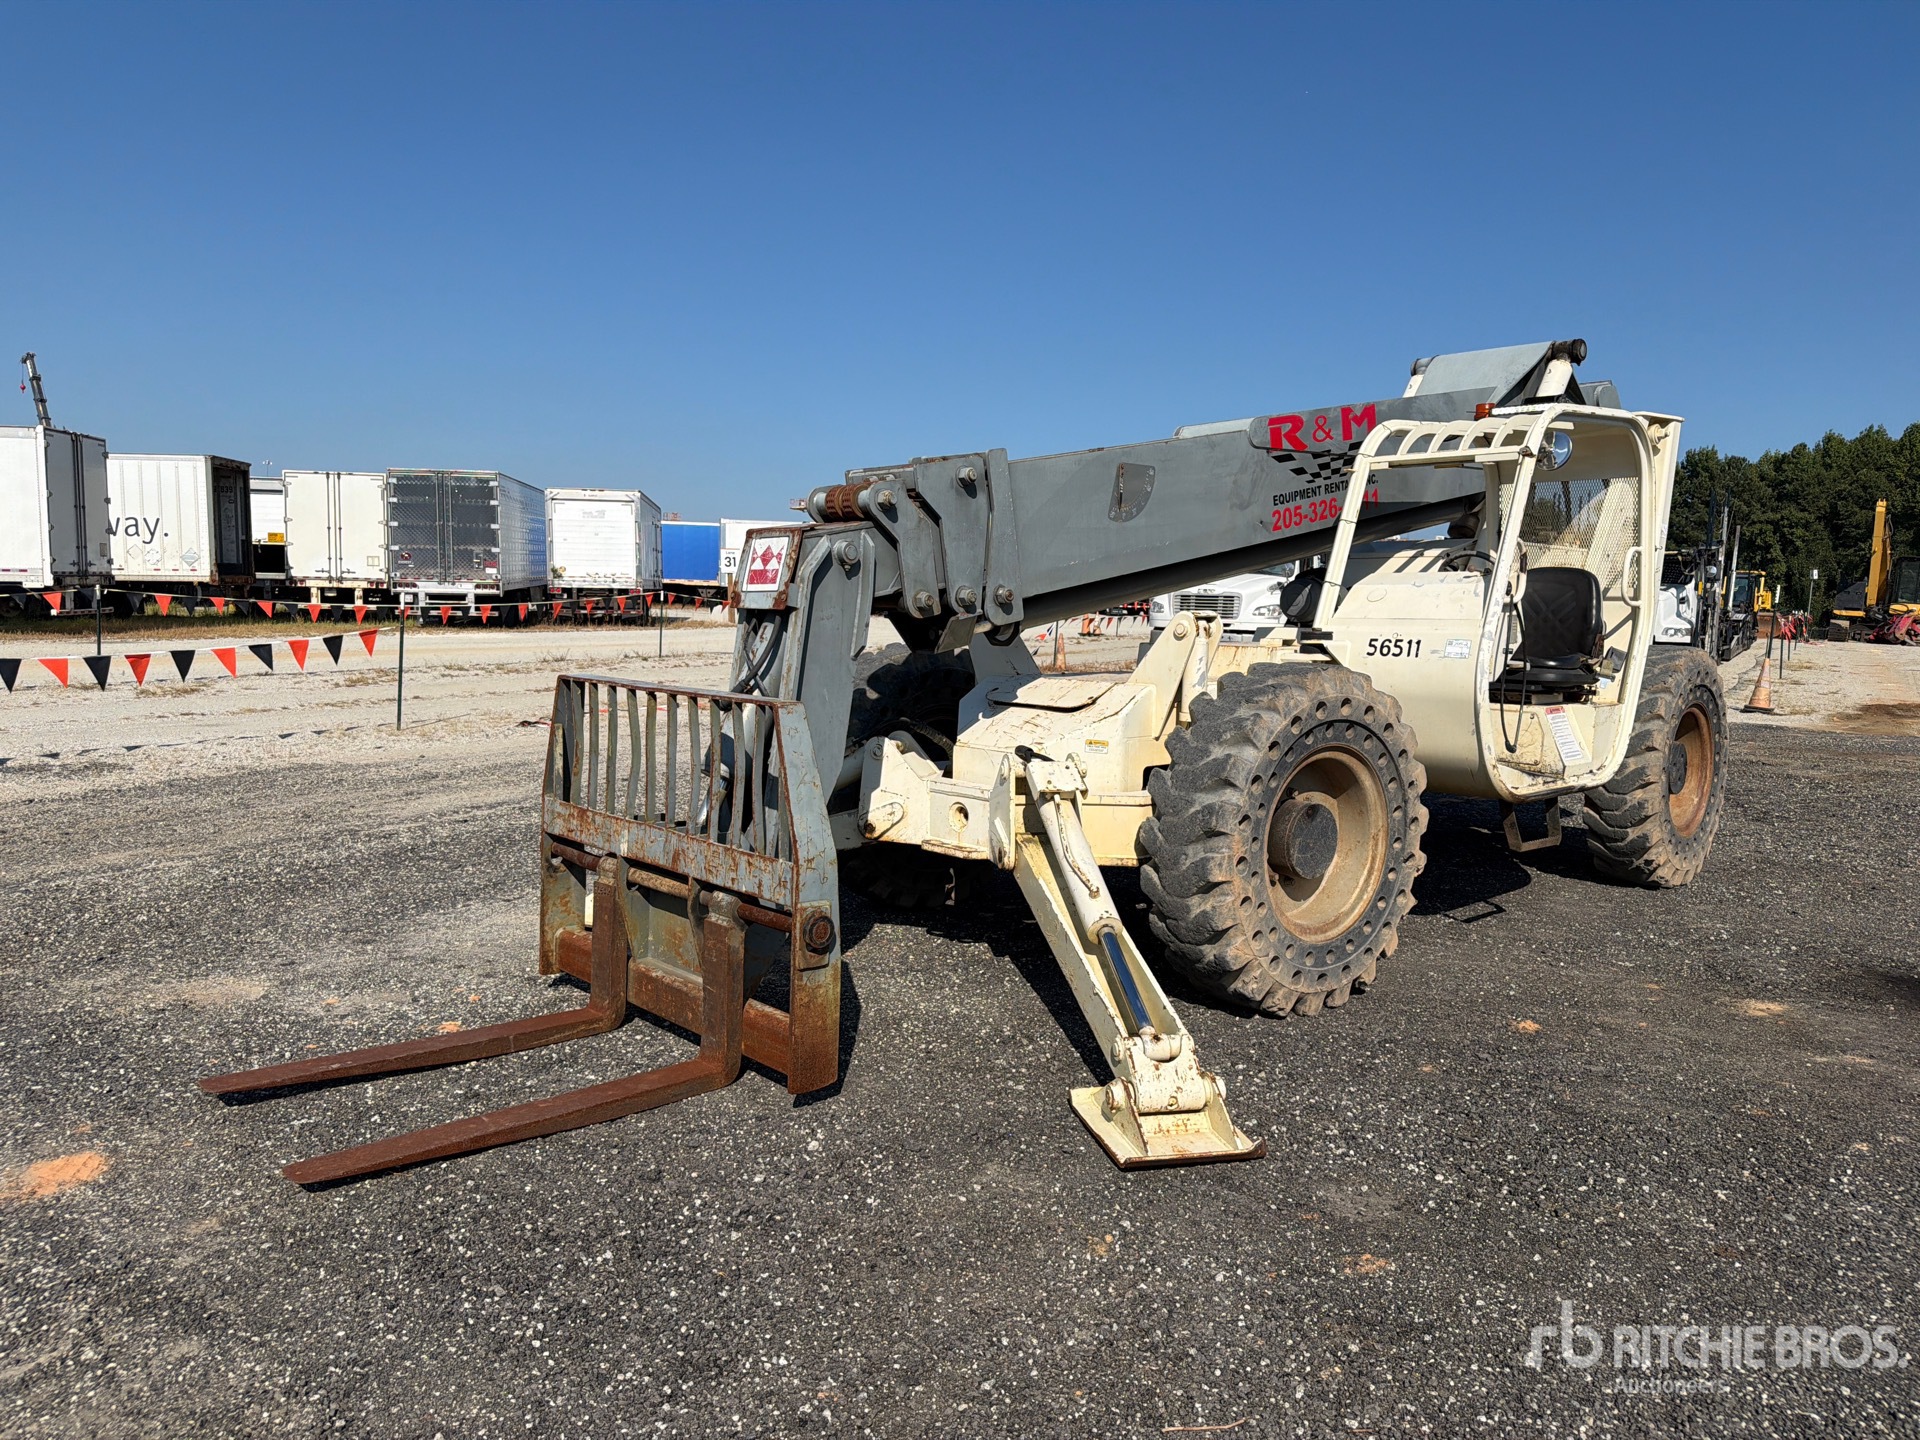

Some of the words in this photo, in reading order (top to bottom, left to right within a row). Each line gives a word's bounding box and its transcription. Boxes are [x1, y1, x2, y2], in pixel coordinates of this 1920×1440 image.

[1268, 415, 1308, 451] R
[1312, 415, 1334, 443] &
[1340, 403, 1376, 441] M
[1273, 485, 1322, 506] EQUIPMENT
[1365, 474, 1379, 486] NC.
[1271, 487, 1379, 532] 205-326-11
[725, 556, 736, 567] 31
[1366, 638, 1421, 658] 56511
